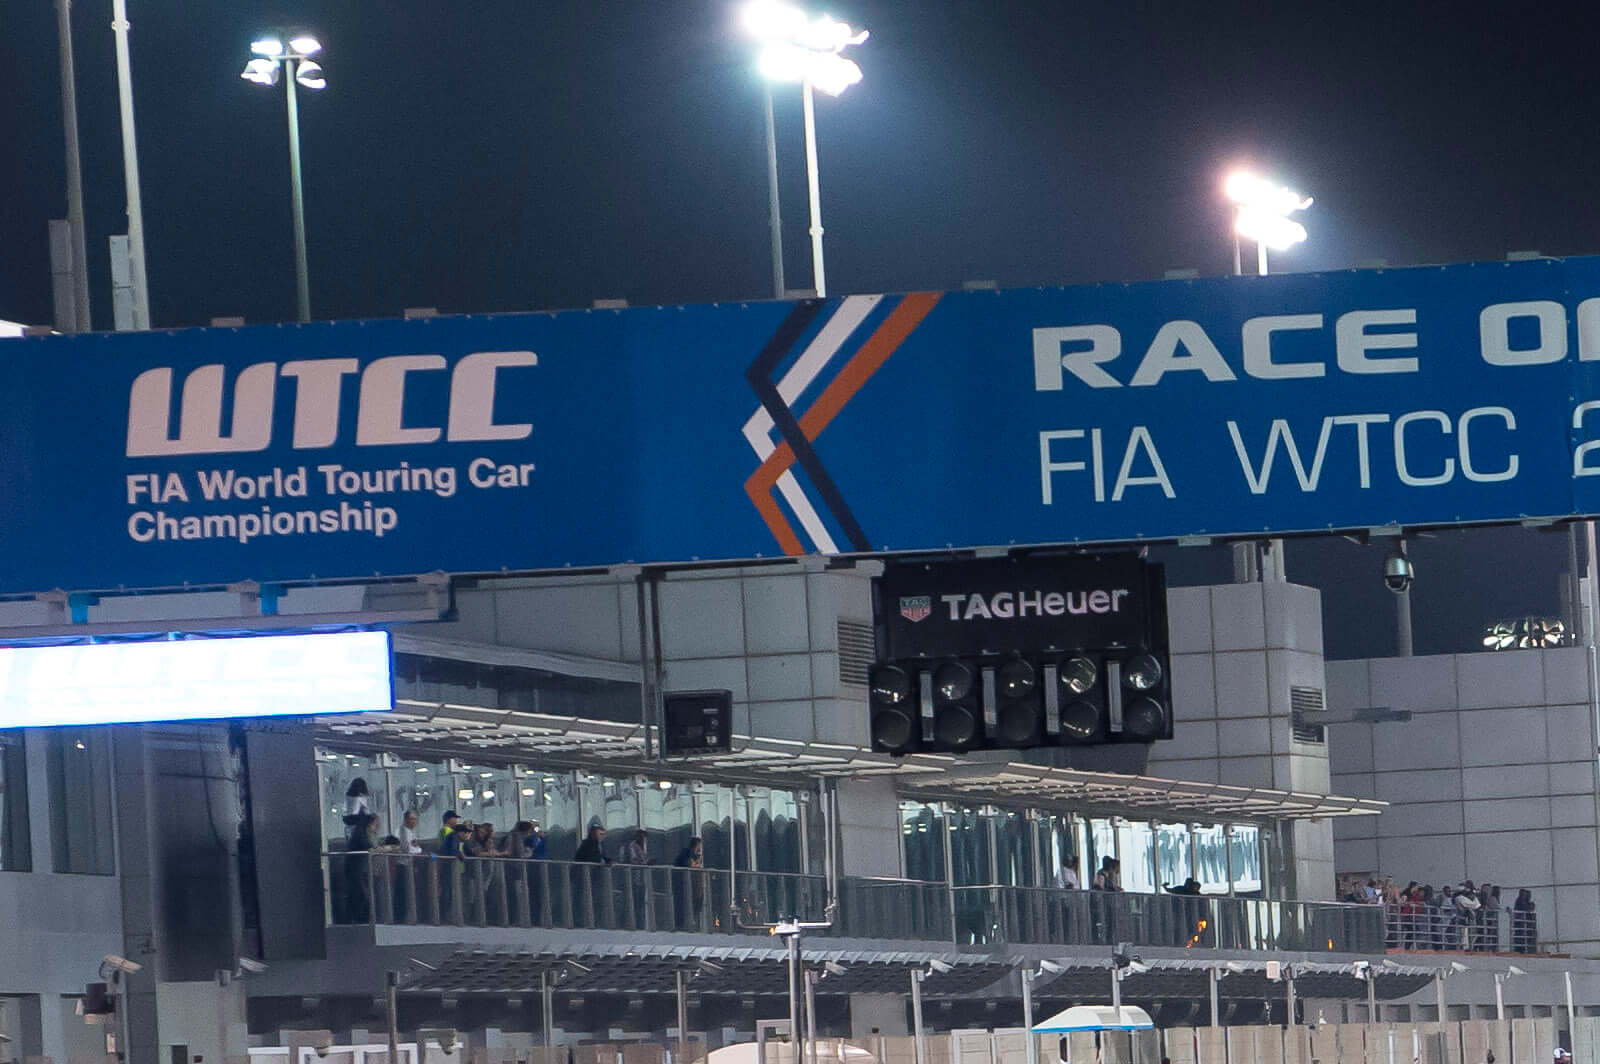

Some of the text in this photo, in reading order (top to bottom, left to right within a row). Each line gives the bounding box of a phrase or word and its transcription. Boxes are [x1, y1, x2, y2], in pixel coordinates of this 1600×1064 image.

[1034, 309, 1419, 391] RACE
[127, 352, 537, 456] WTCC
[127, 458, 535, 504] FIA World Touring Car
[1039, 426, 1177, 505] FIA
[1228, 407, 1519, 495] WTCC
[128, 502, 397, 543] Championship
